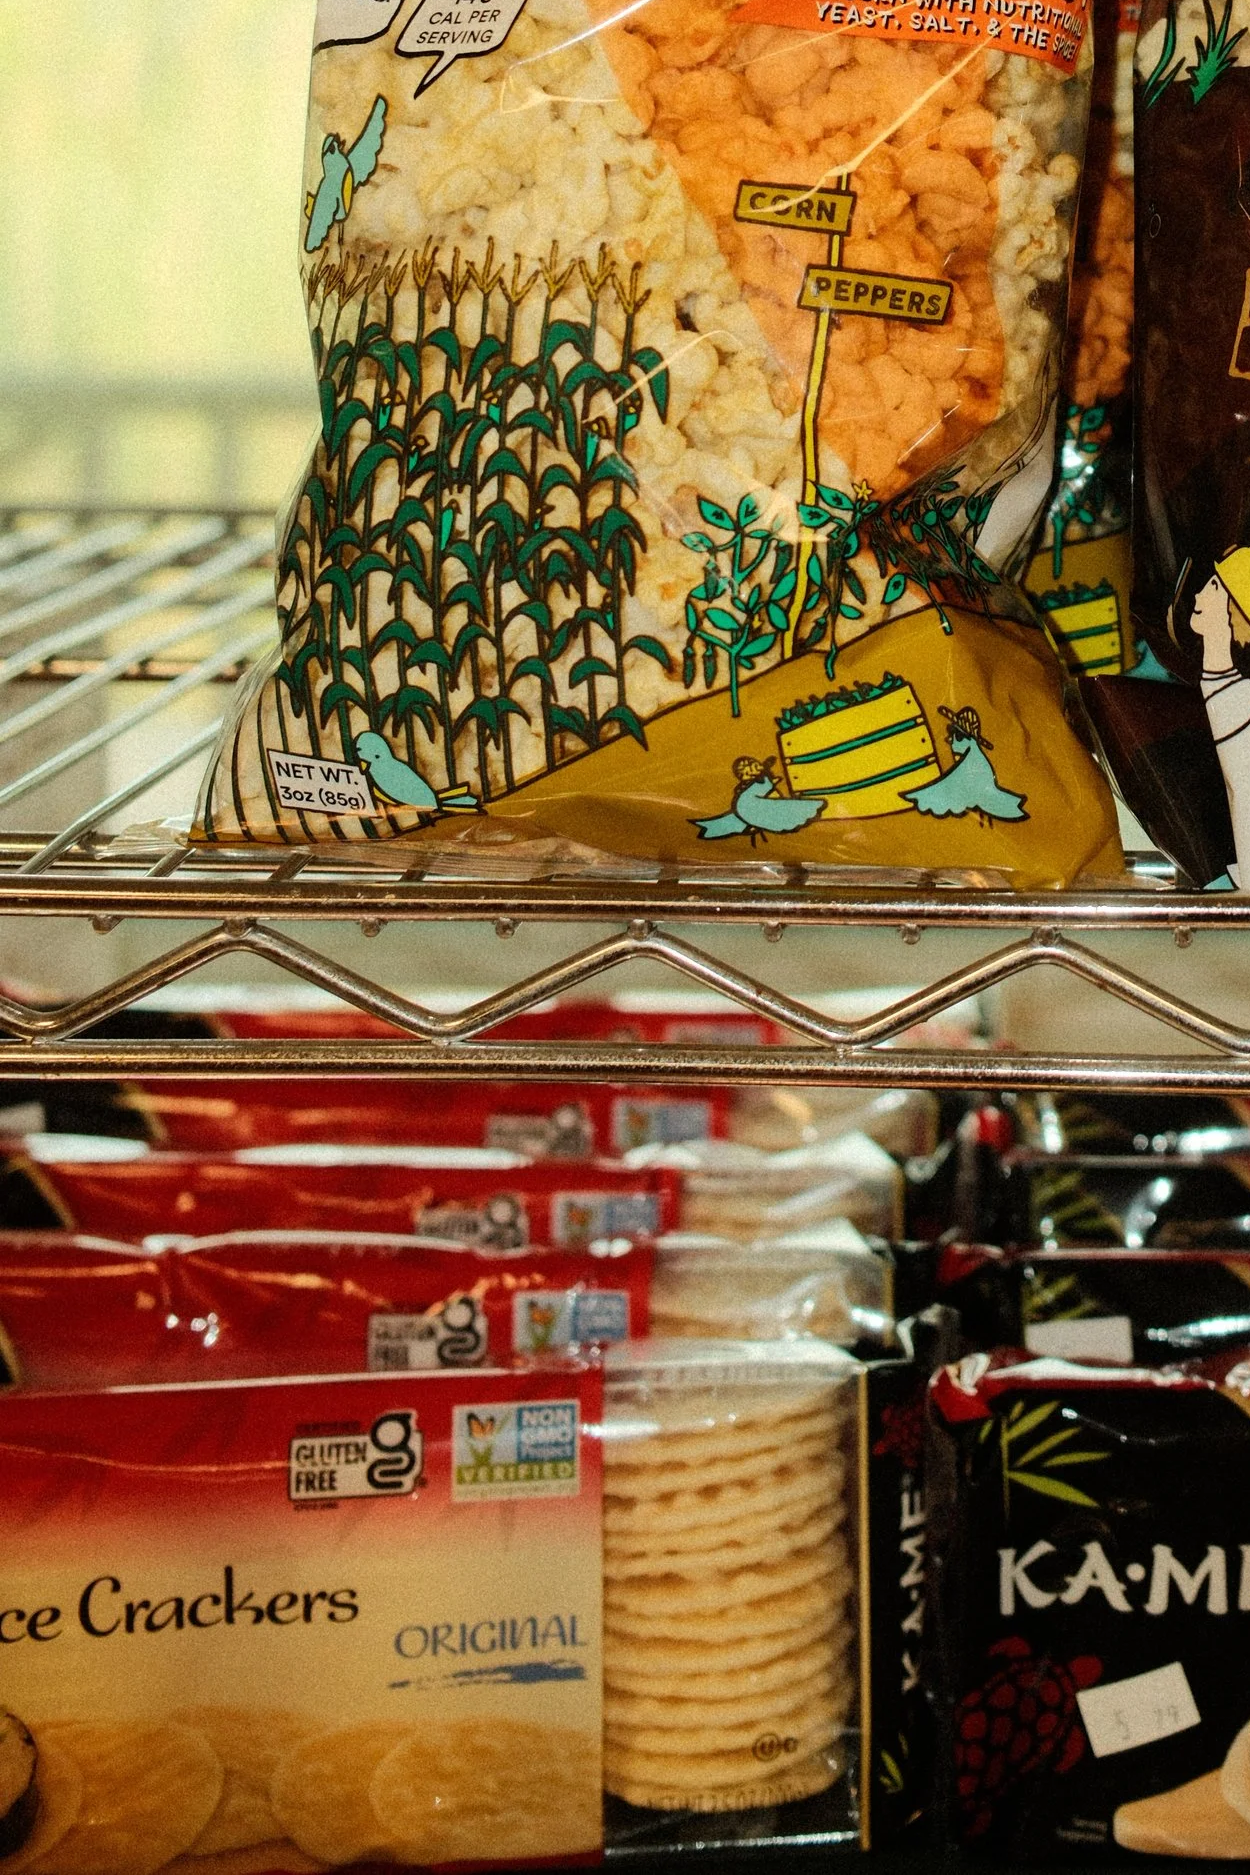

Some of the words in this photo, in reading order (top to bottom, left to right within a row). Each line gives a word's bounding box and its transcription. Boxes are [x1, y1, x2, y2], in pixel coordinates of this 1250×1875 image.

[428, 11, 462, 25] CAL
[467, 8, 501, 24] PER
[415, 29, 495, 45] SERVING
[814, 0, 902, 31] YEAST,
[908, 12, 980, 37] SALT,
[986, 17, 1002, 38] &
[1010, 23, 1051, 50] THE
[1051, 31, 1079, 64] SPICE!
[749, 191, 838, 224] CORN
[812, 275, 943, 317] PEPPERS
[275, 760, 316, 781] NET
[318, 765, 360, 786] WT.
[279, 785, 316, 803] 3oz
[317, 787, 367, 811] (85g)
[520, 1407, 573, 1426] NON
[294, 1440, 369, 1466] GLUTEN
[295, 1468, 338, 1493] FREE
[77, 1565, 360, 1637] Crackers
[393, 1614, 589, 1661] ORIGINAL
